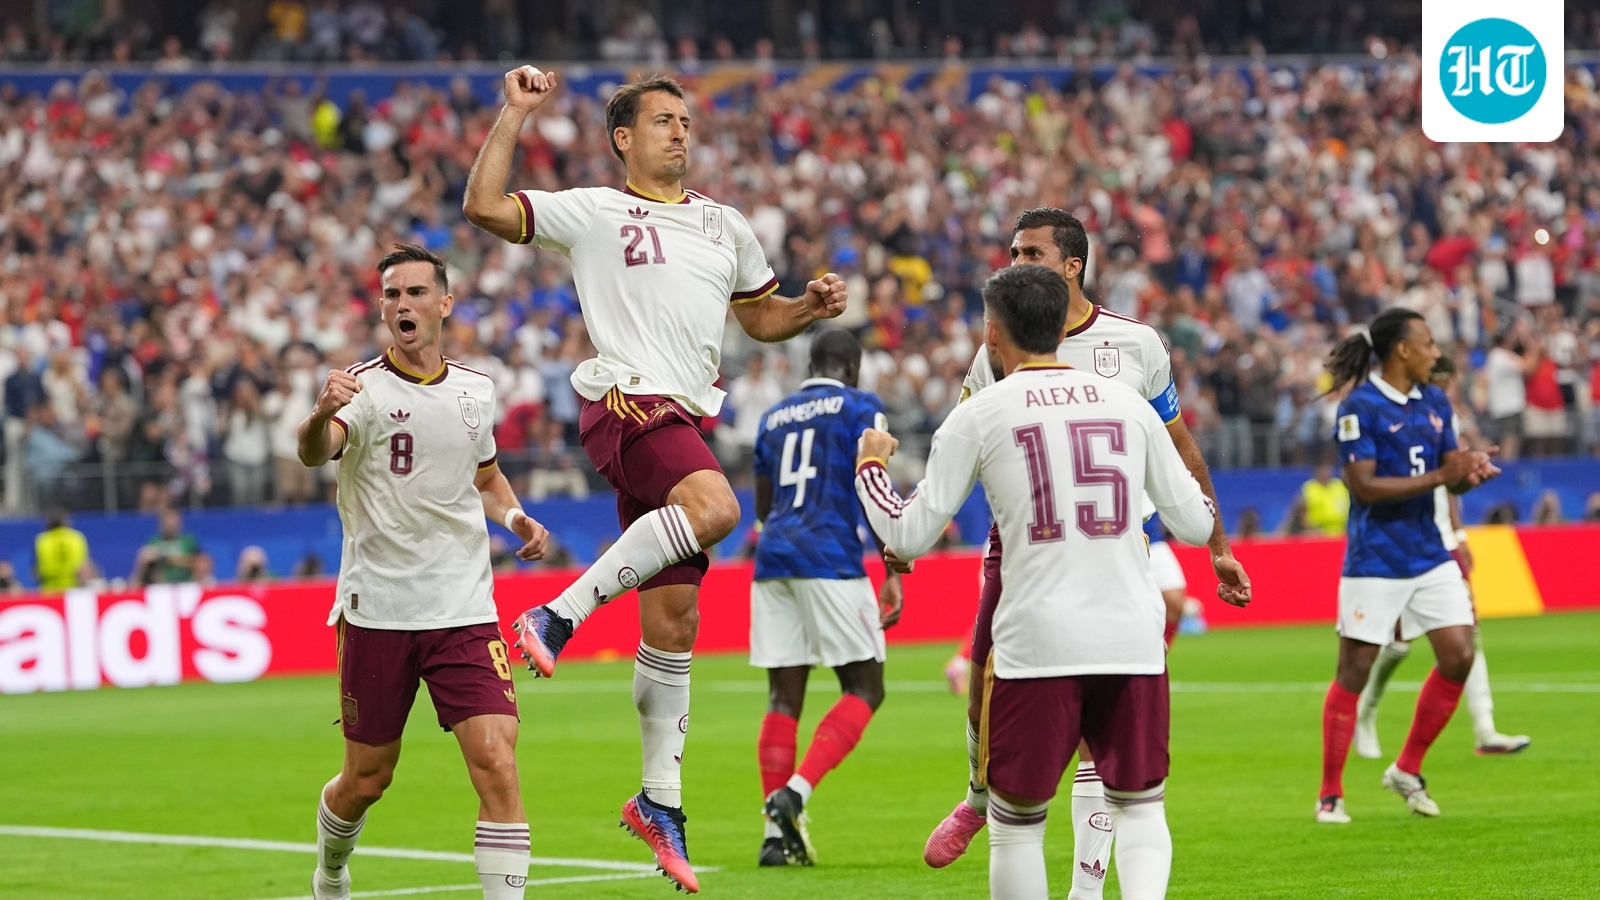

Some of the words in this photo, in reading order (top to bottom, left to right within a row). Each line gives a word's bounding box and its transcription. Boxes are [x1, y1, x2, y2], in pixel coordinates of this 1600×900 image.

[619, 224, 667, 268] 21
[766, 396, 845, 432] UPAMECANO
[1026, 386, 1080, 408] ALEX
[1083, 384, 1106, 403] B.
[389, 432, 414, 476] 8
[779, 428, 818, 508] 4
[1408, 445, 1426, 478] 5
[1012, 418, 1130, 545] 15
[0, 582, 273, 695] ald's
[487, 640, 511, 681] 8
